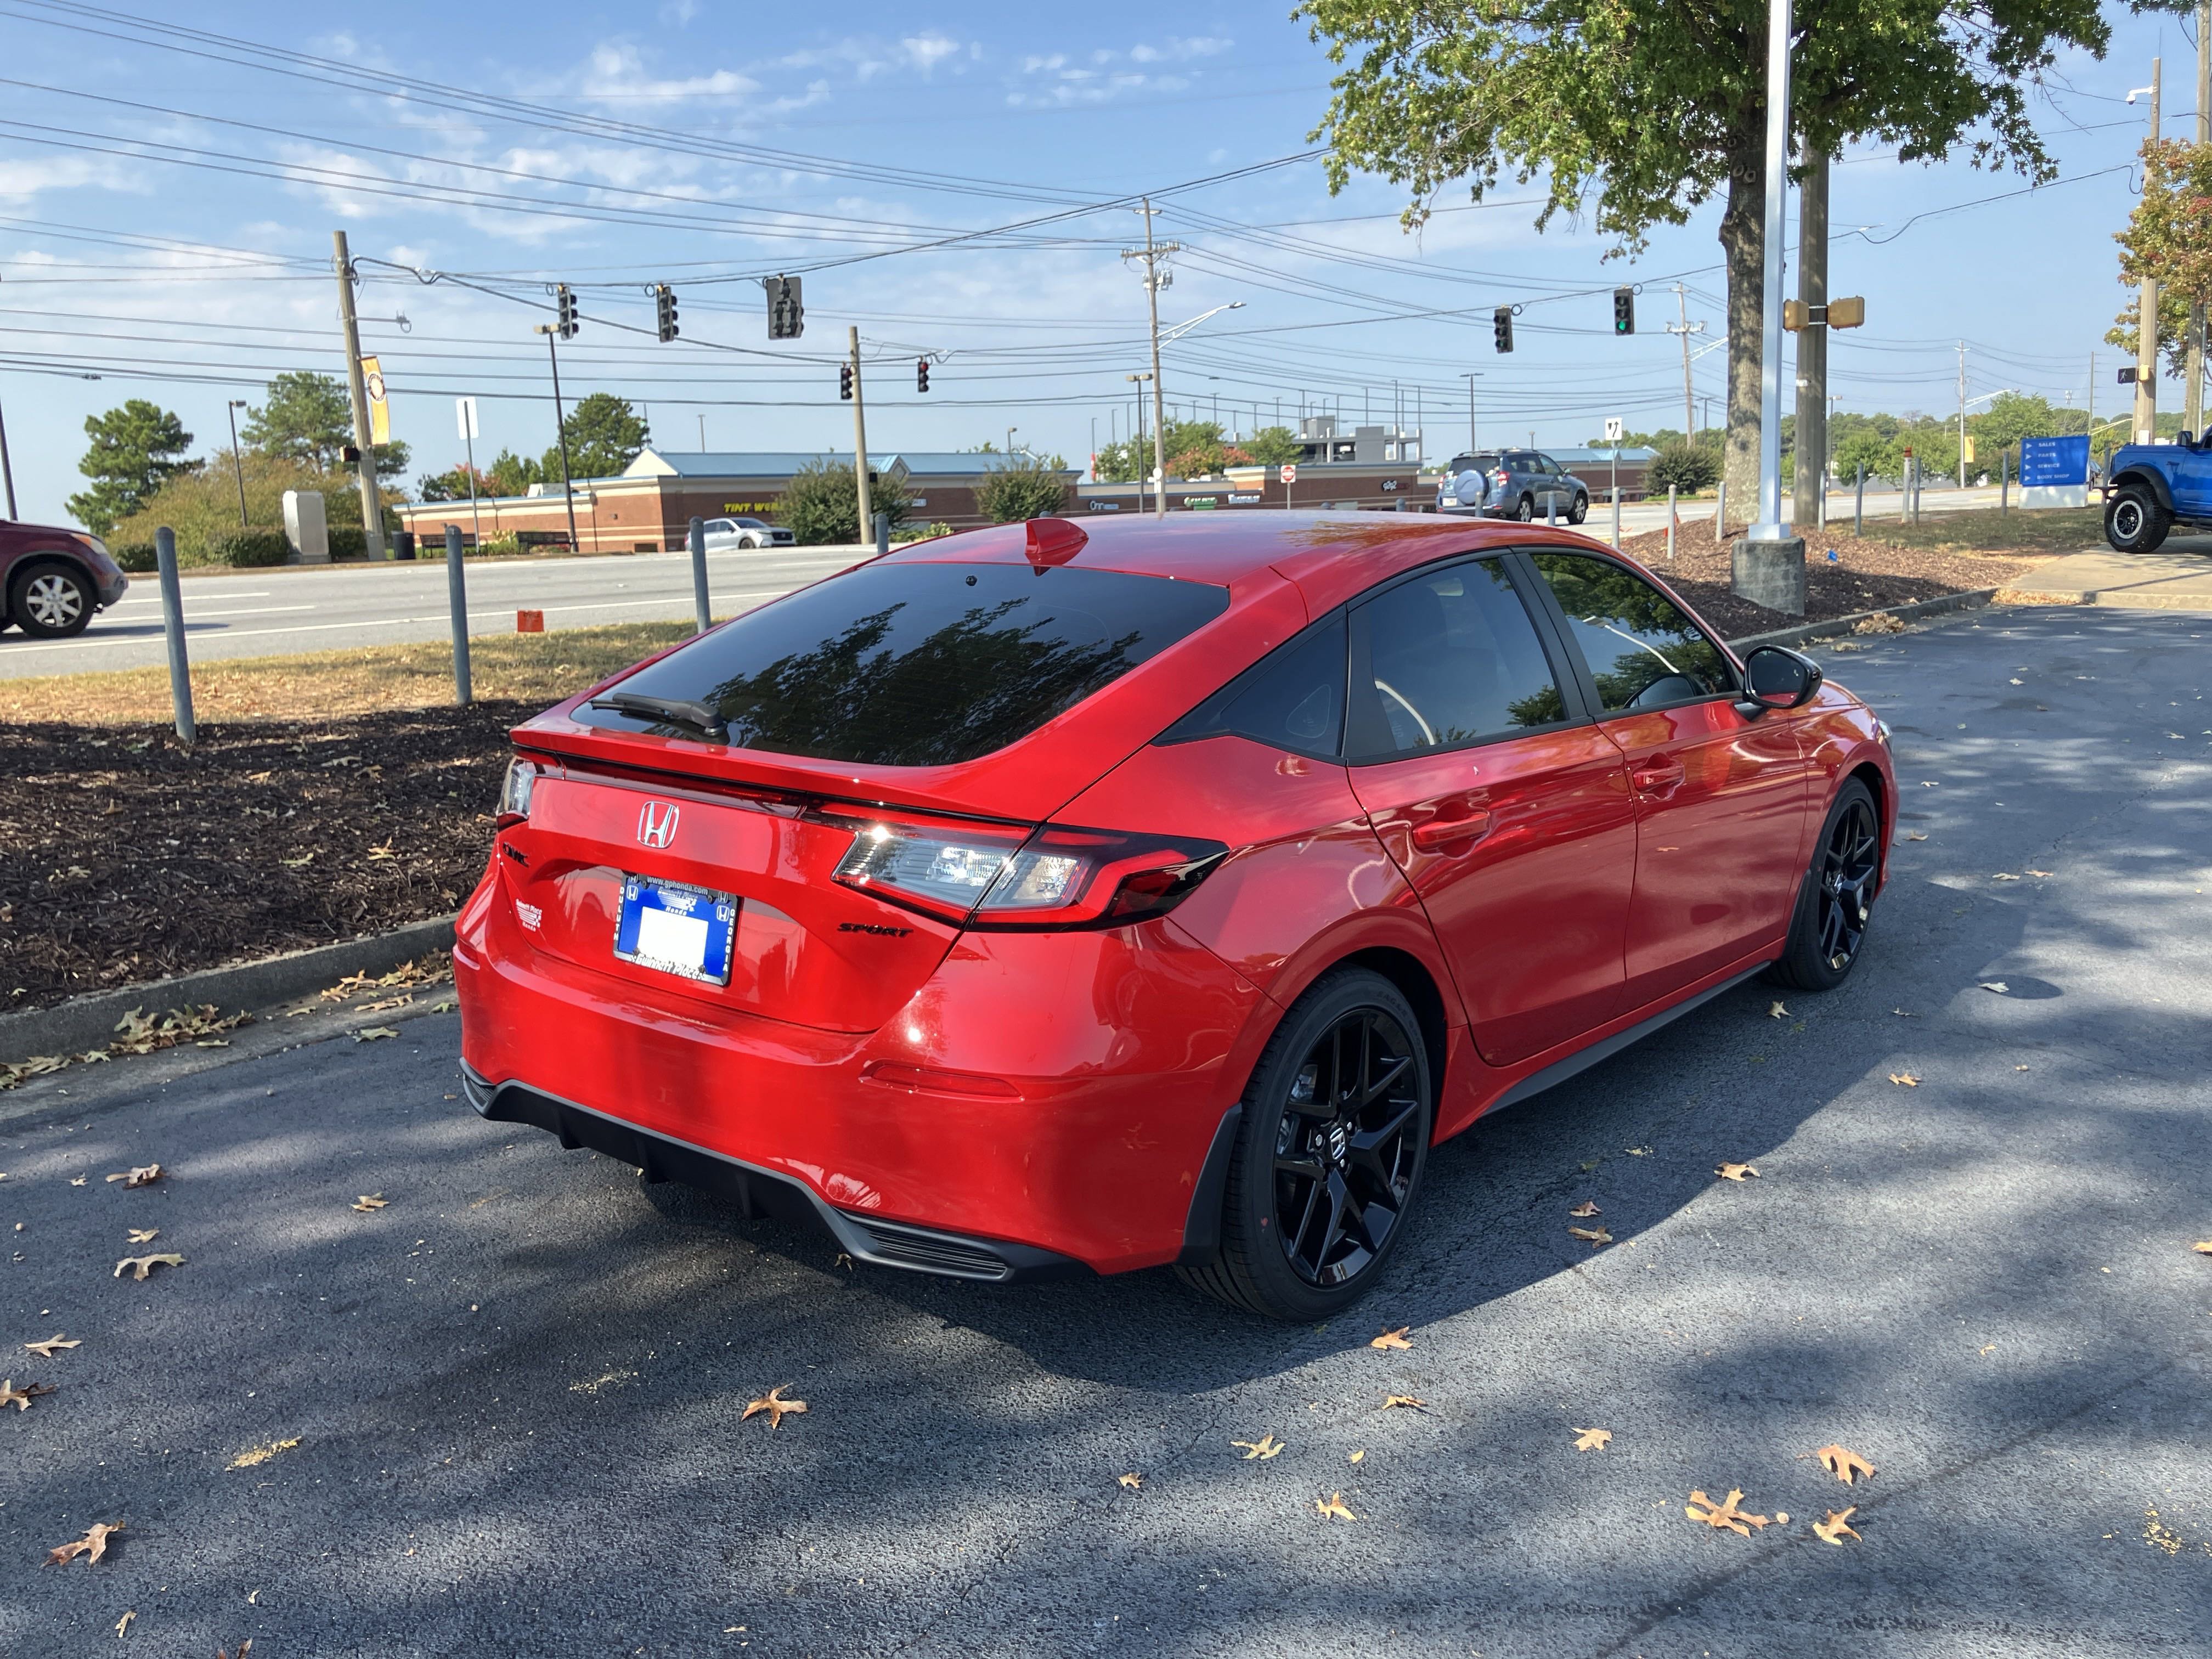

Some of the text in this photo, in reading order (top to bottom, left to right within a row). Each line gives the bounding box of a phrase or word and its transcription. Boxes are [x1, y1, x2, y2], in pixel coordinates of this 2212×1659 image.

[724, 503, 752, 513] TINT
[647, 876, 708, 895] www.gphonda.com
[837, 923, 914, 937] SPORT
